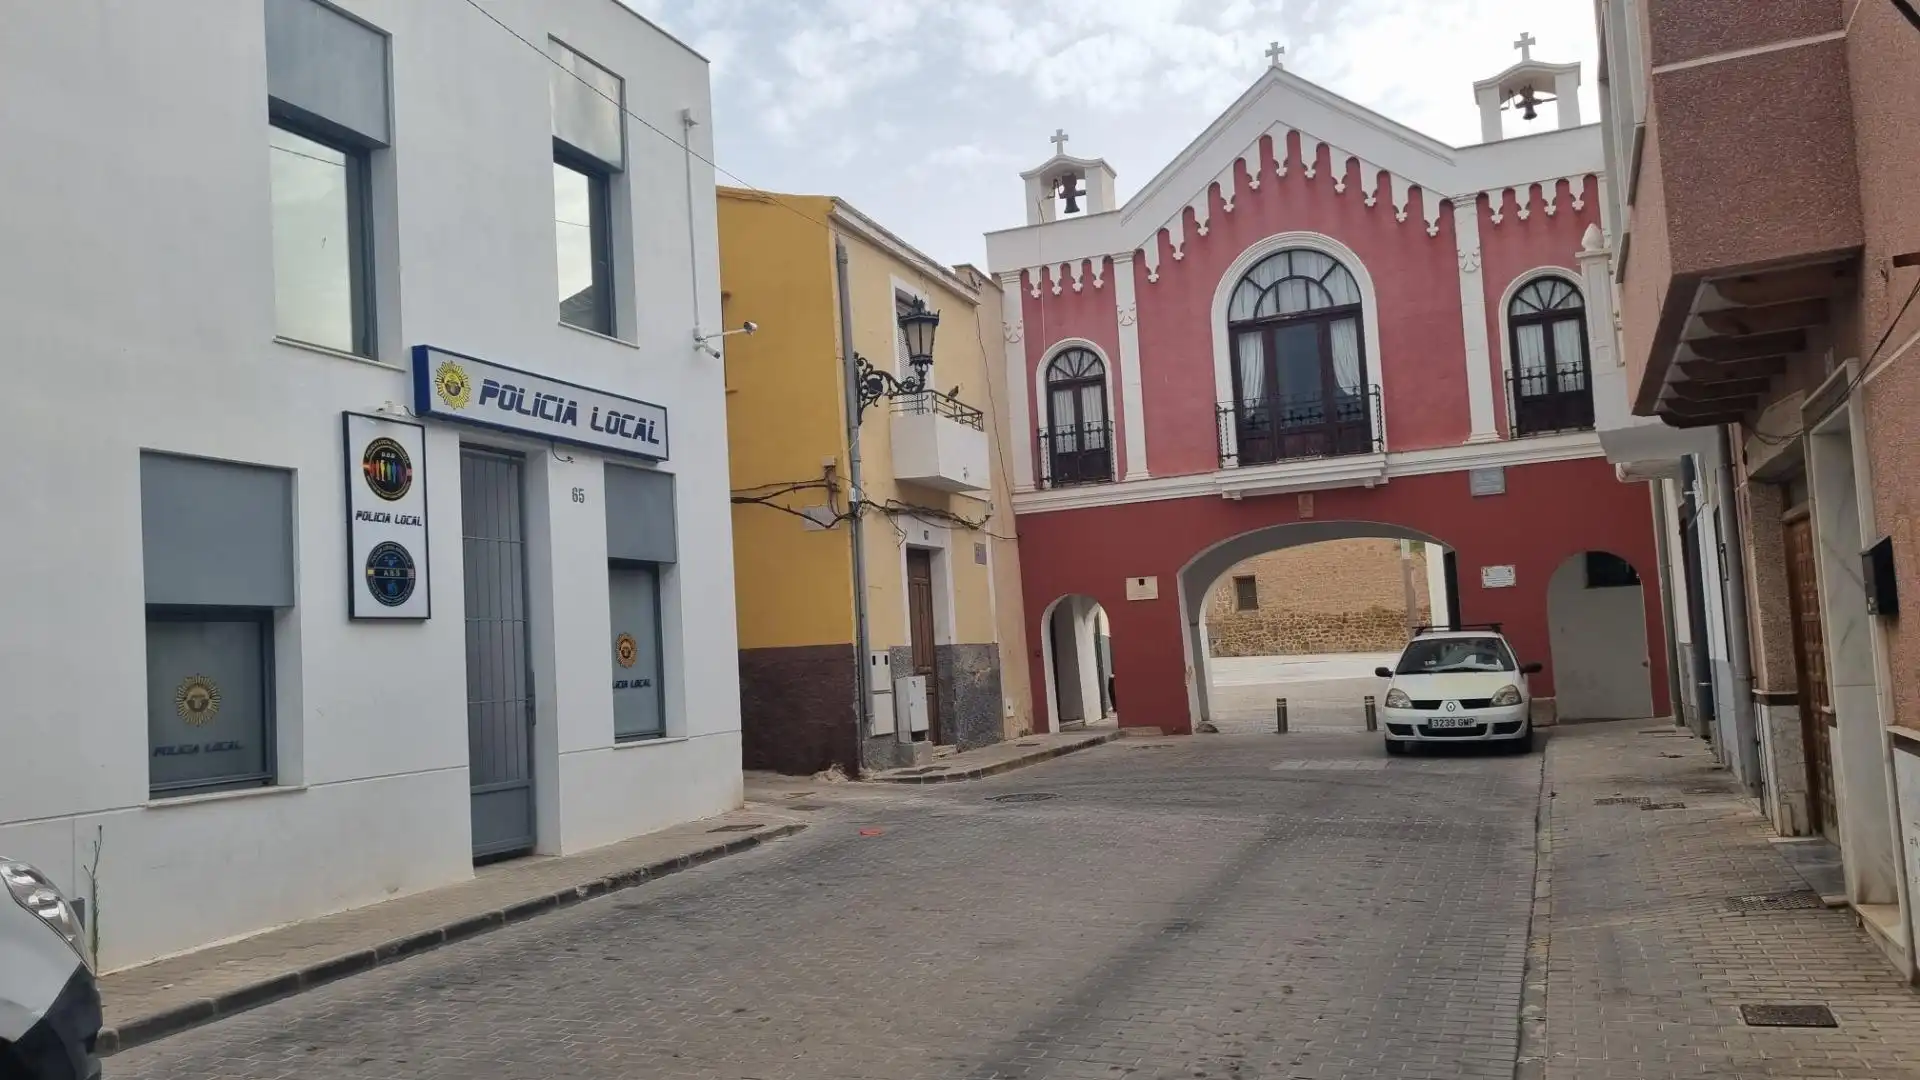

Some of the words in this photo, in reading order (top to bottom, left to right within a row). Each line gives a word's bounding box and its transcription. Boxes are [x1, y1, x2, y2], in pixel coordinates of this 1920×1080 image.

[479, 378, 577, 427] POLICIA
[590, 406, 660, 445] LOCAL
[571, 486, 585, 503] 65
[355, 510, 391, 524] POLICIA
[394, 514, 422, 527] LOCAL
[630, 679, 652, 688] LOCAL
[1433, 719, 1455, 727] 3239
